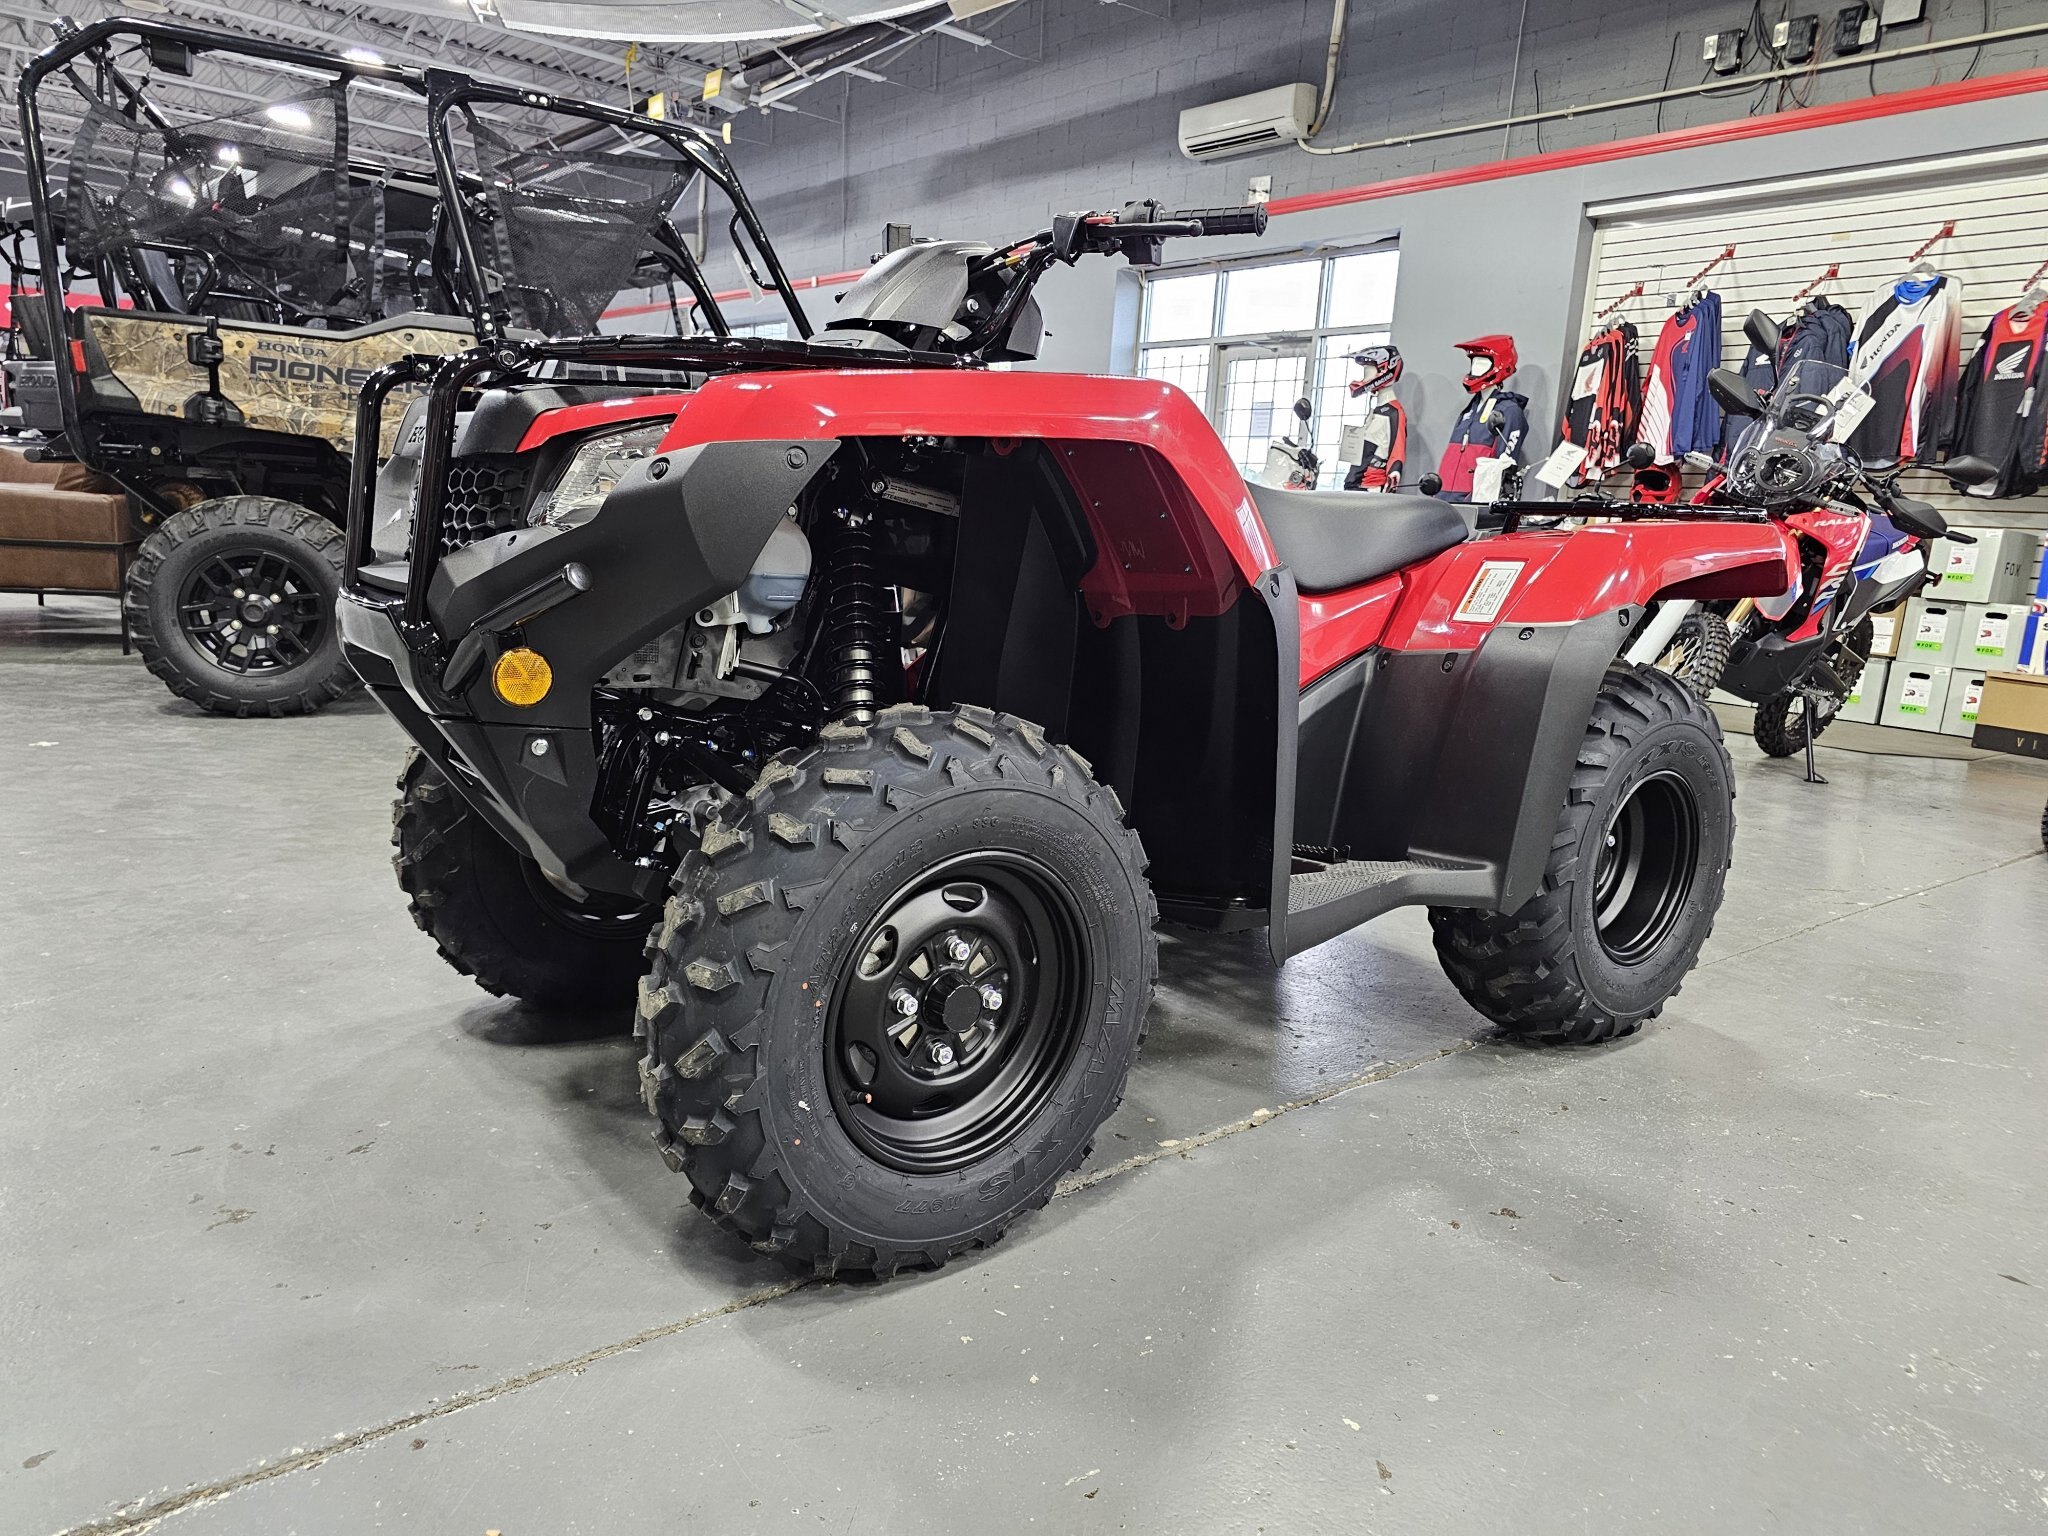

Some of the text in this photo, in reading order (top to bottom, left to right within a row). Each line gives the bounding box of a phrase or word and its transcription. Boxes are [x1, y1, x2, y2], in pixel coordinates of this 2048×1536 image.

[257, 341, 328, 358] HONDA
[1869, 323, 1902, 360] HONDA
[1813, 516, 1862, 528] RALLY
[2004, 561, 2022, 577] FOX
[979, 975, 1127, 1201] MAXXIS
